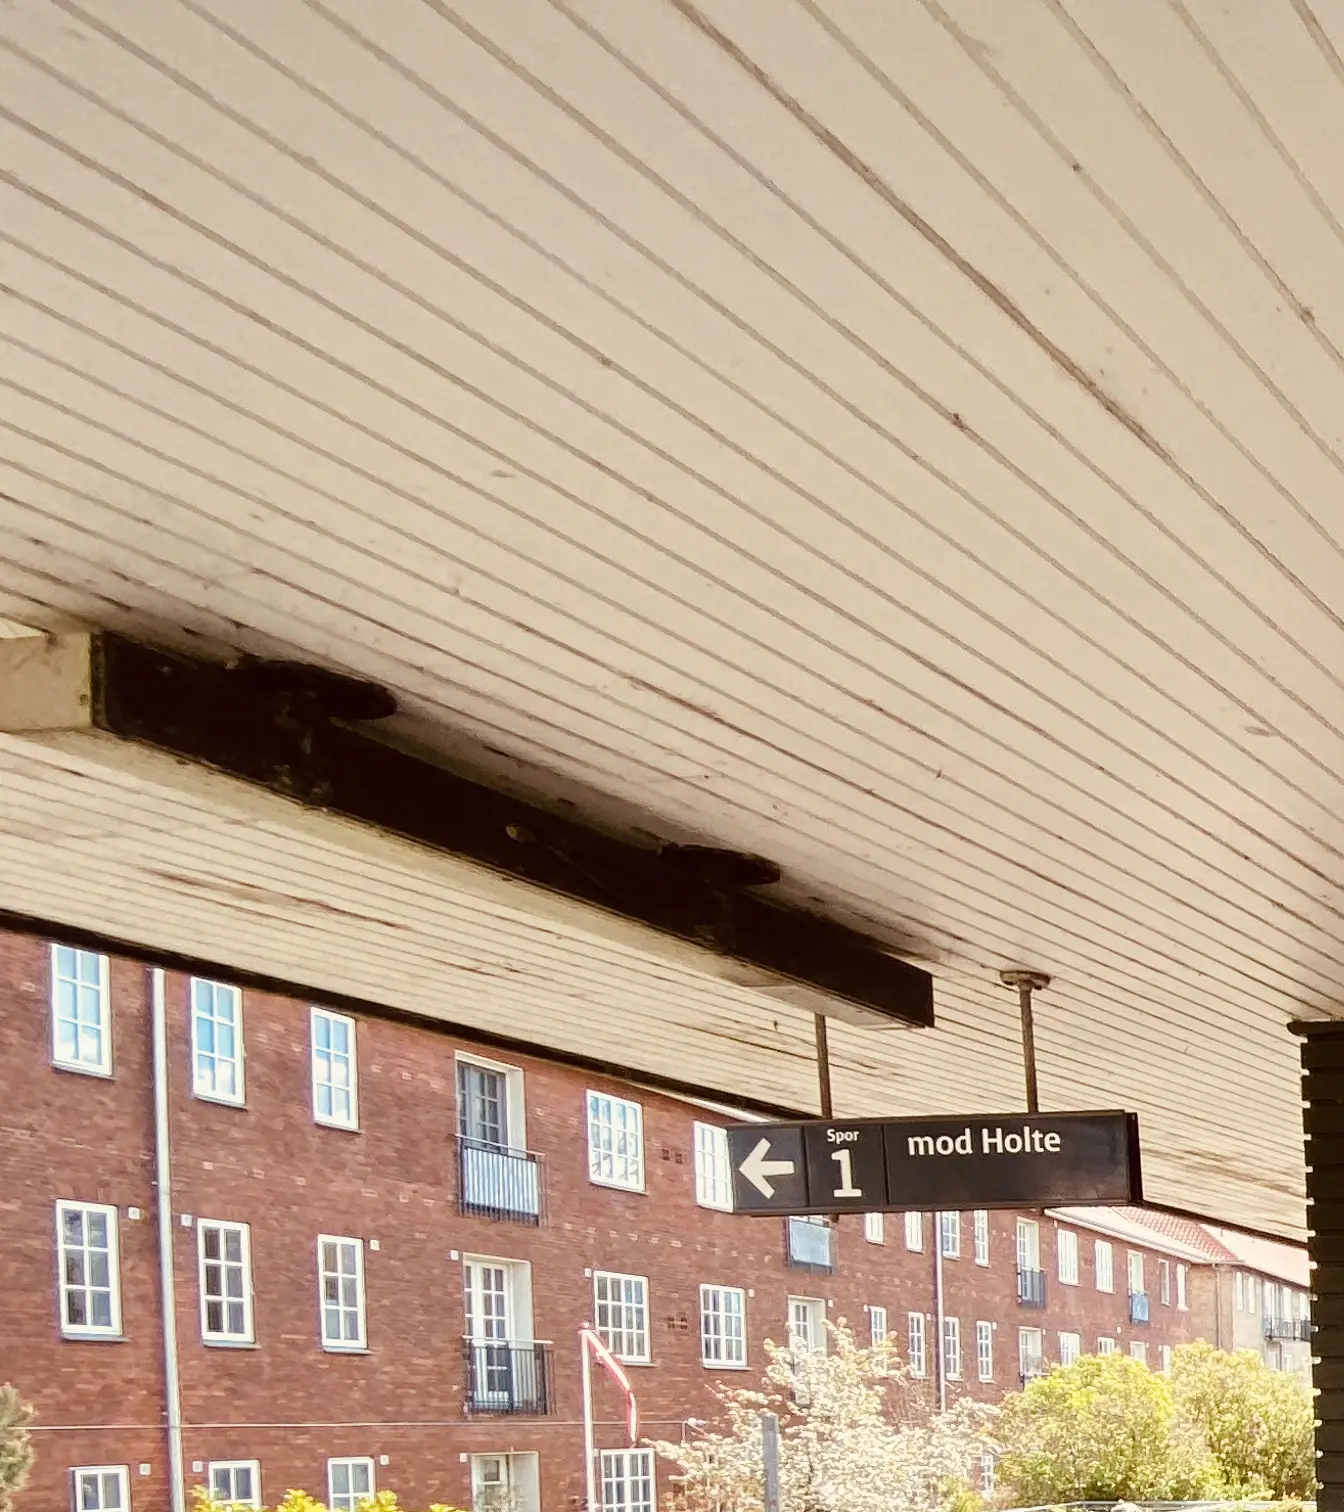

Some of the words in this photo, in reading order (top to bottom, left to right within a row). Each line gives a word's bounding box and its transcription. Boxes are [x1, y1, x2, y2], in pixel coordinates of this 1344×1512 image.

[827, 1128, 859, 1145] Spor
[908, 1128, 973, 1156] mod
[981, 1126, 1061, 1154] Holte
[831, 1148, 862, 1198] 1
